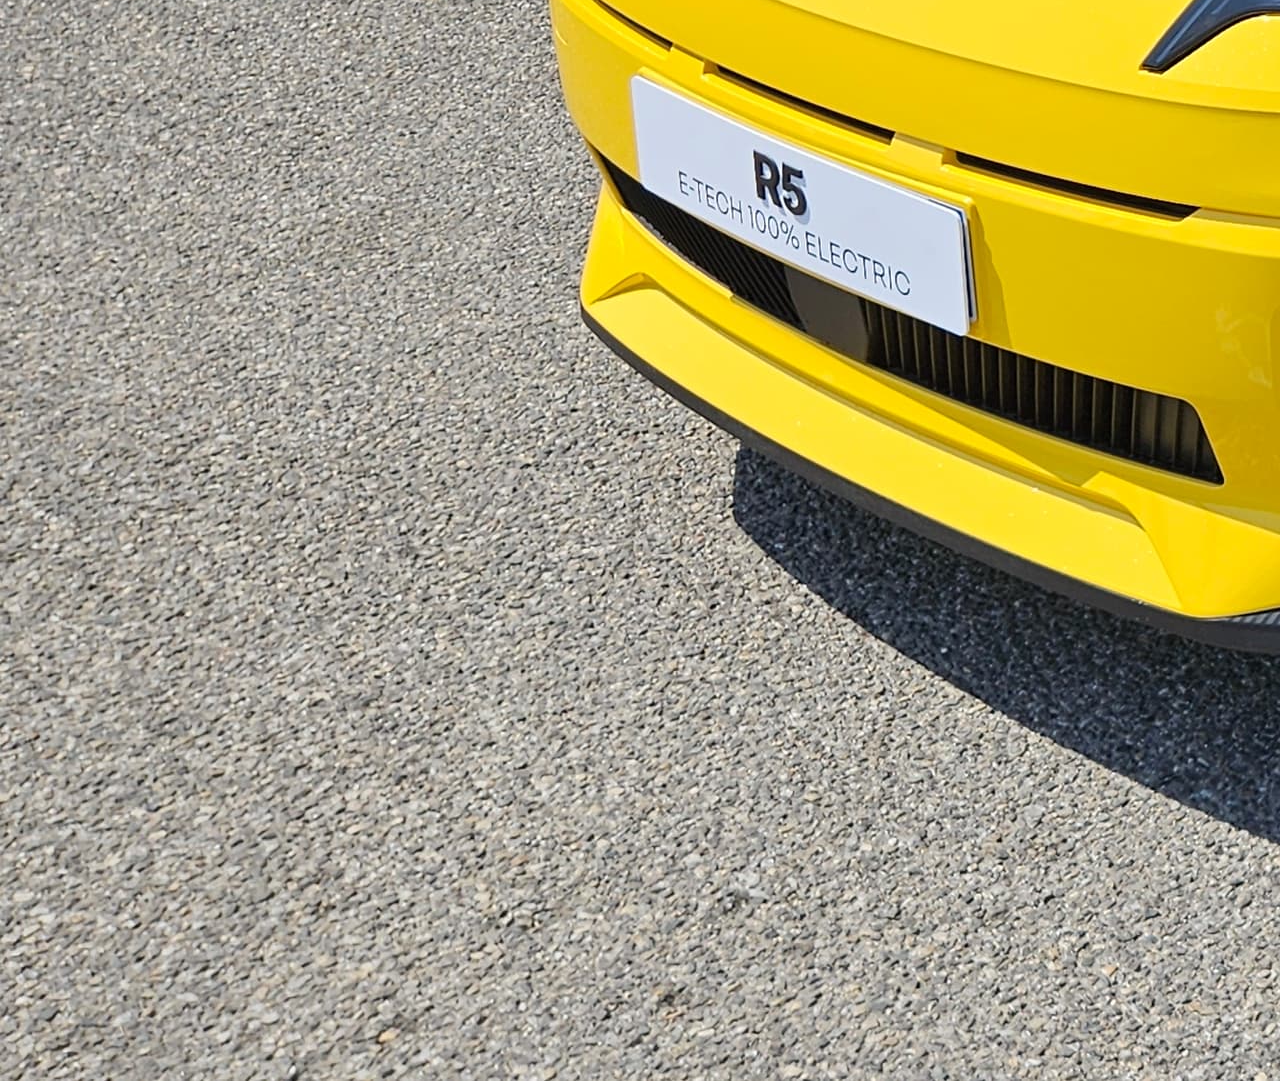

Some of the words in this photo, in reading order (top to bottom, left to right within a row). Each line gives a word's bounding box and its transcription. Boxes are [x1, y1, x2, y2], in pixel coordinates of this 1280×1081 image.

[753, 149, 807, 216] R5
[678, 170, 744, 224] E-TECH
[748, 205, 801, 251] 100%
[805, 230, 912, 296] ELECTRIC
